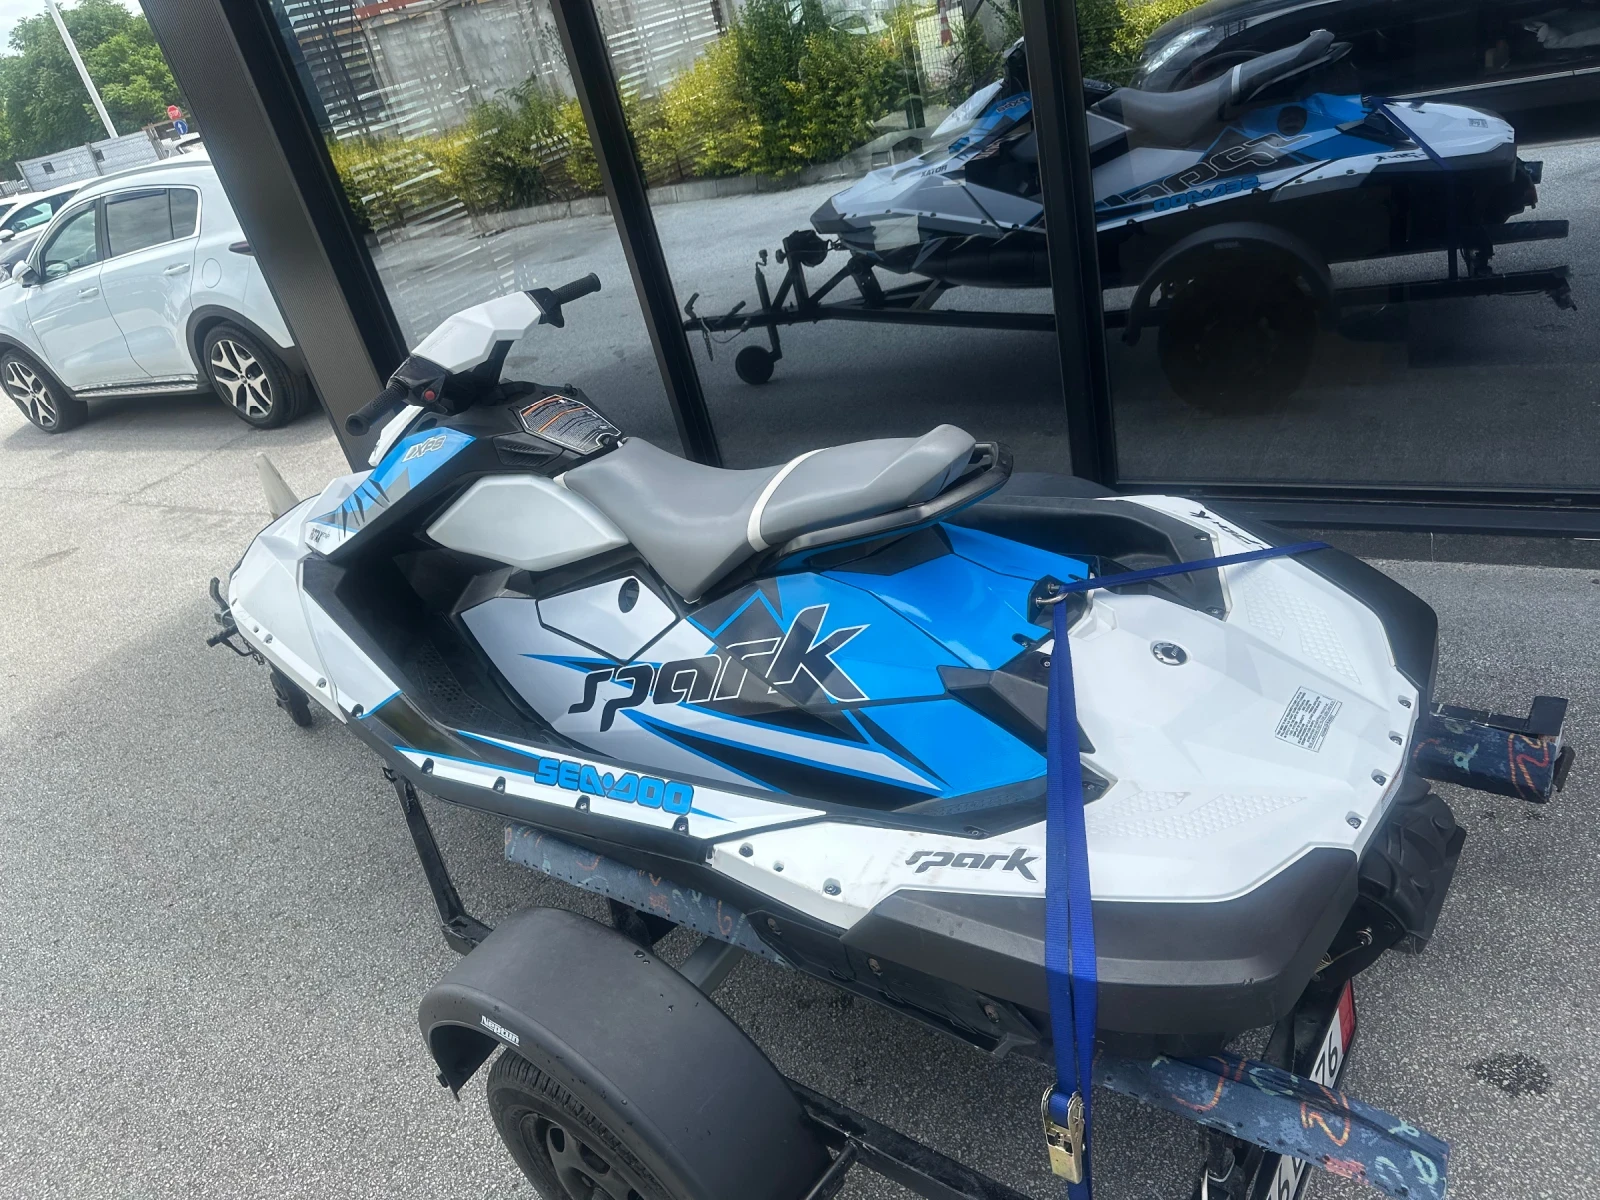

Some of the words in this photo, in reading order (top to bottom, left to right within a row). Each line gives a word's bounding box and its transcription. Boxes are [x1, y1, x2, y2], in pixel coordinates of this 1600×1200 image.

[568, 603, 873, 732] spark
[904, 847, 1041, 882] spark
[480, 1015, 519, 1045] Neptun
